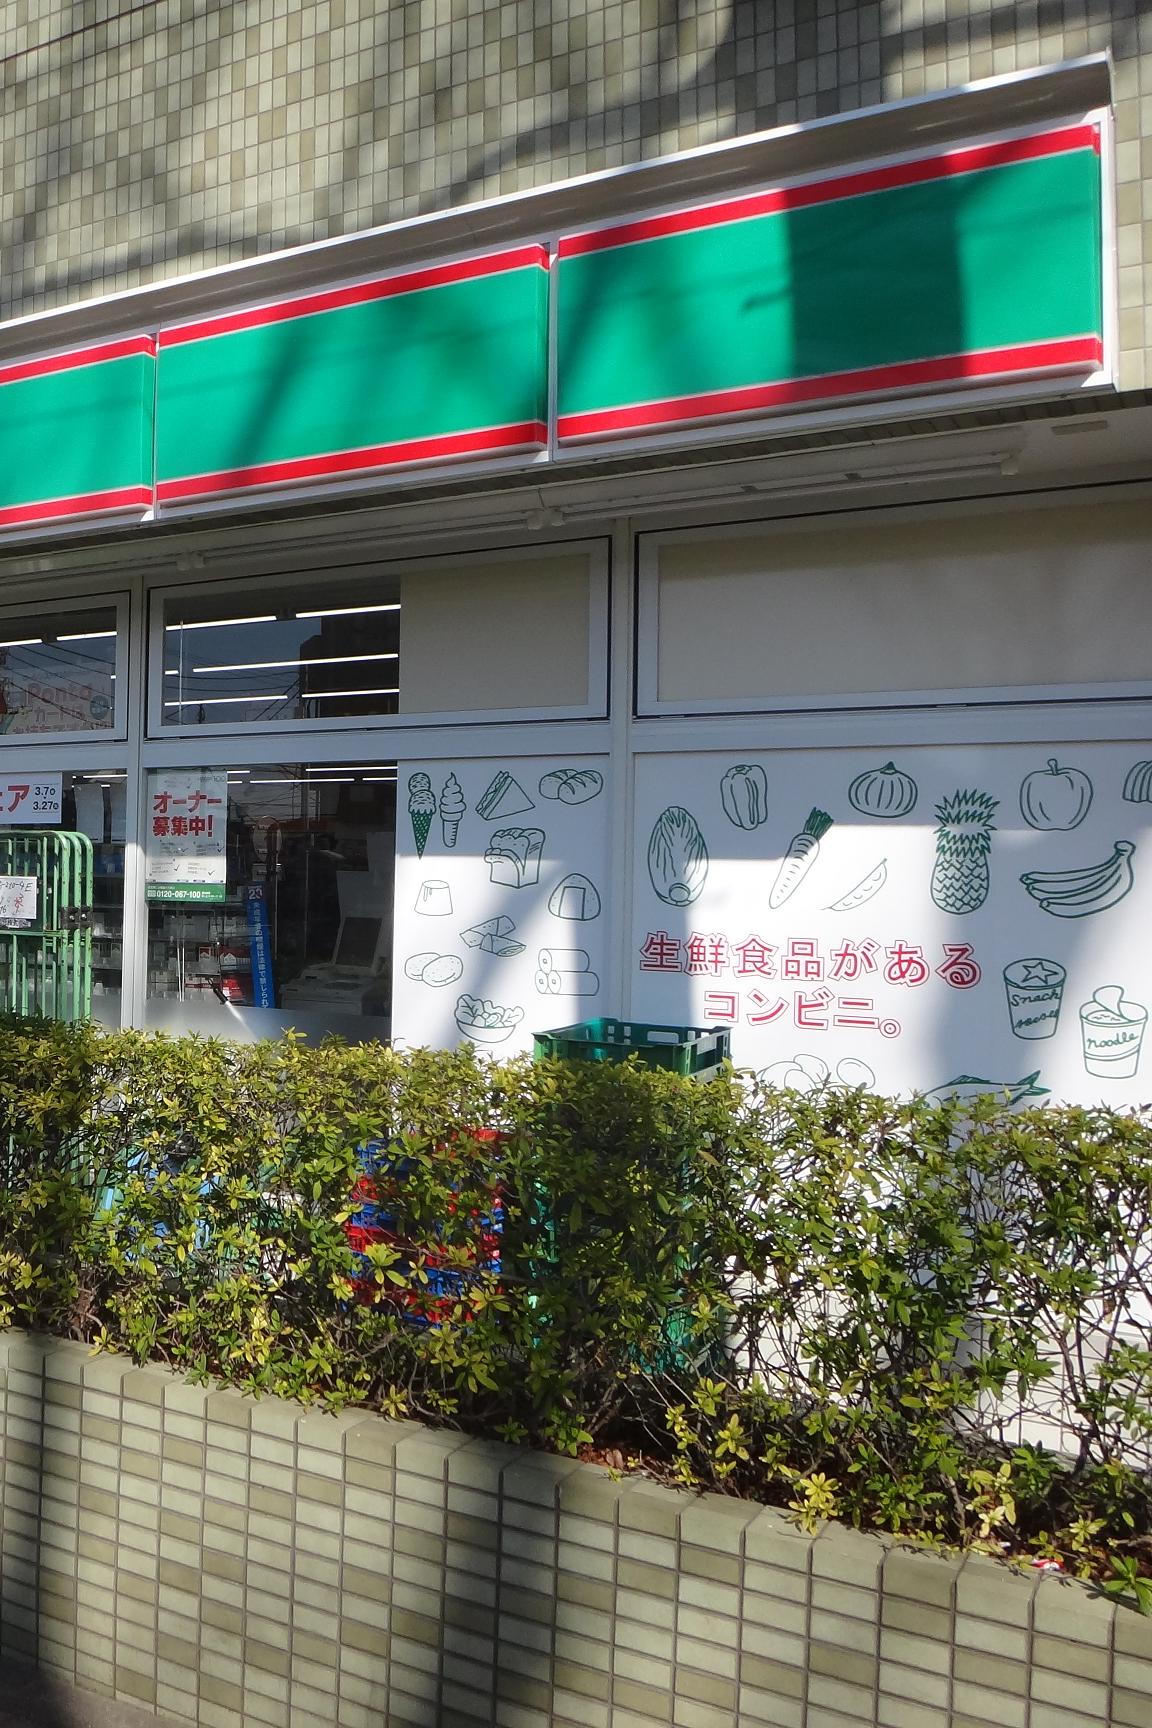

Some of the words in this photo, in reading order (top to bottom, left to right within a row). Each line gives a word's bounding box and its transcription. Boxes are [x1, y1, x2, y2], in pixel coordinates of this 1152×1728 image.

[153, 790, 222, 813] オーナー
[153, 815, 214, 837] 募集中!
[640, 931, 982, 989] 生鮮食品がある
[704, 986, 902, 1038] コンビニ。
[1086, 1032, 1139, 1050] noodle
